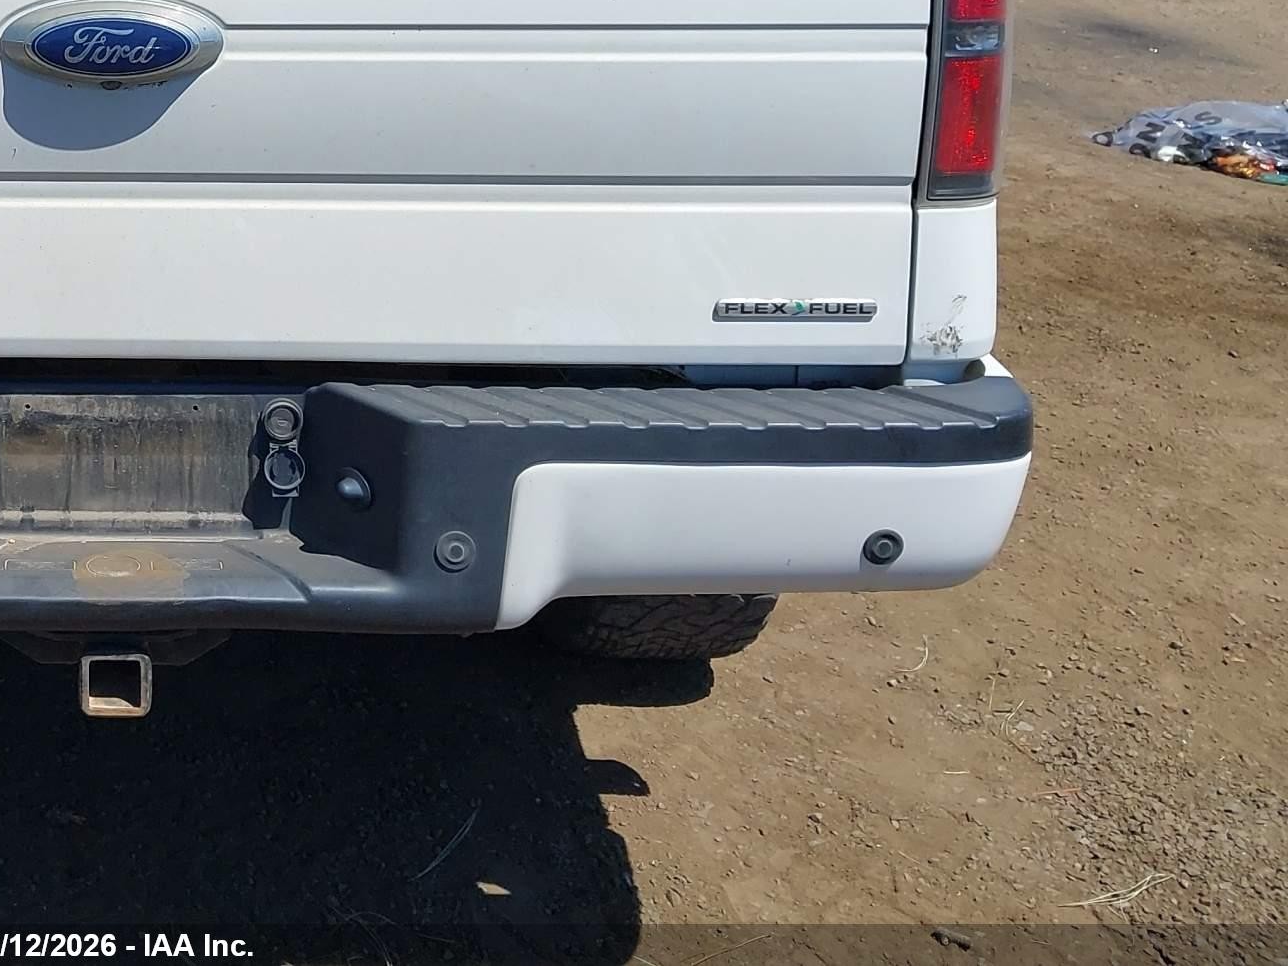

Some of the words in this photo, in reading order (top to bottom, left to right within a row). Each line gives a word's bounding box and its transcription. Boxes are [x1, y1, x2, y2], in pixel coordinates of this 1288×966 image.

[64, 26, 160, 64] Ford
[723, 302, 787, 315] FLEX
[808, 302, 873, 315] FUEL
